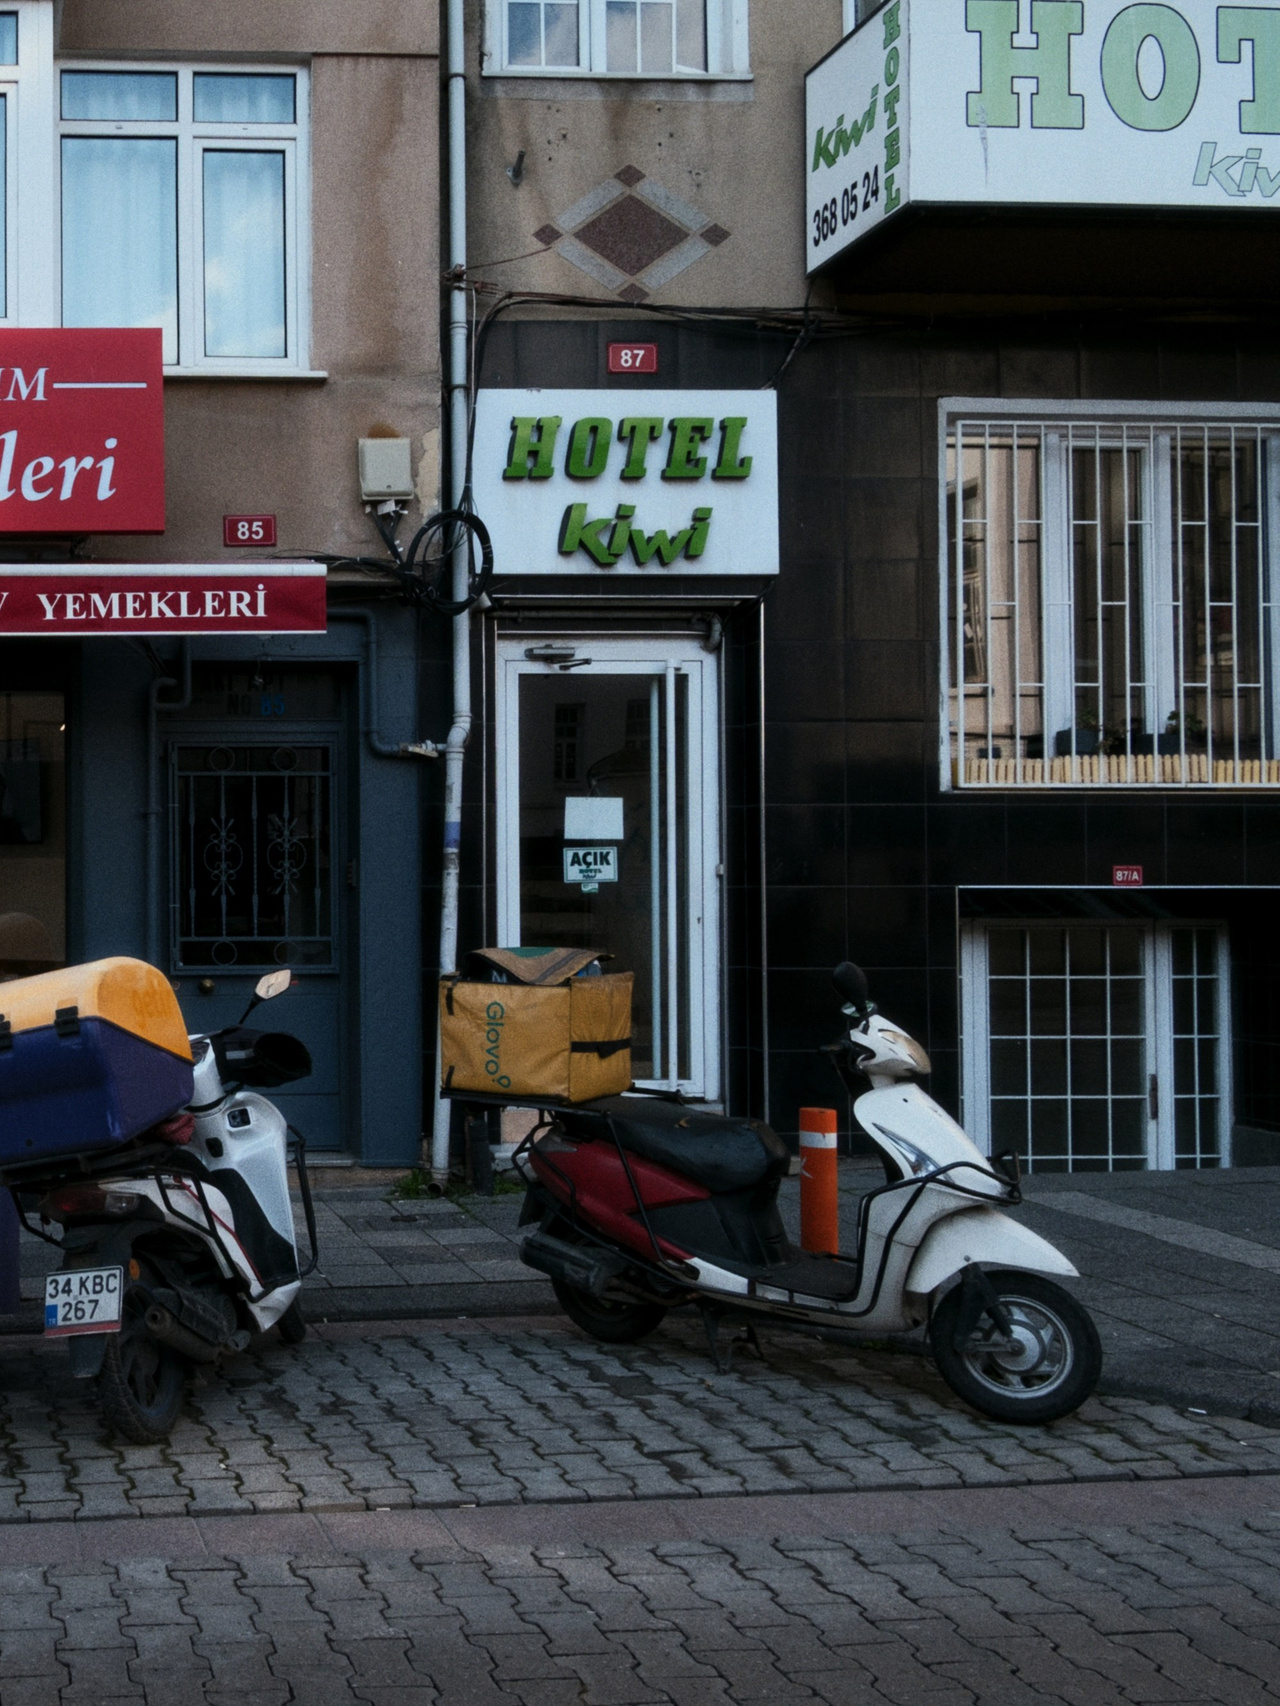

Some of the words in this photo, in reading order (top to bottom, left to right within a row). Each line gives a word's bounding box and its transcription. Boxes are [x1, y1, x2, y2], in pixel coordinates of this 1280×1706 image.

[883, 1, 901, 215] HOTEL
[813, 197, 838, 248] 368
[841, 180, 858, 227] 05
[862, 164, 880, 213] 24
[620, 350, 645, 368] 87
[502, 416, 753, 481] HOTEL
[237, 522, 264, 540] 85
[36, 583, 267, 621] YEMEKLERİ
[570, 851, 611, 868] AÇIK
[1115, 870, 1140, 881] 87/A
[485, 1001, 505, 1076] Glovo
[48, 1277, 72, 1299] 34
[79, 1273, 118, 1296] KBC
[61, 1299, 100, 1322] 267
